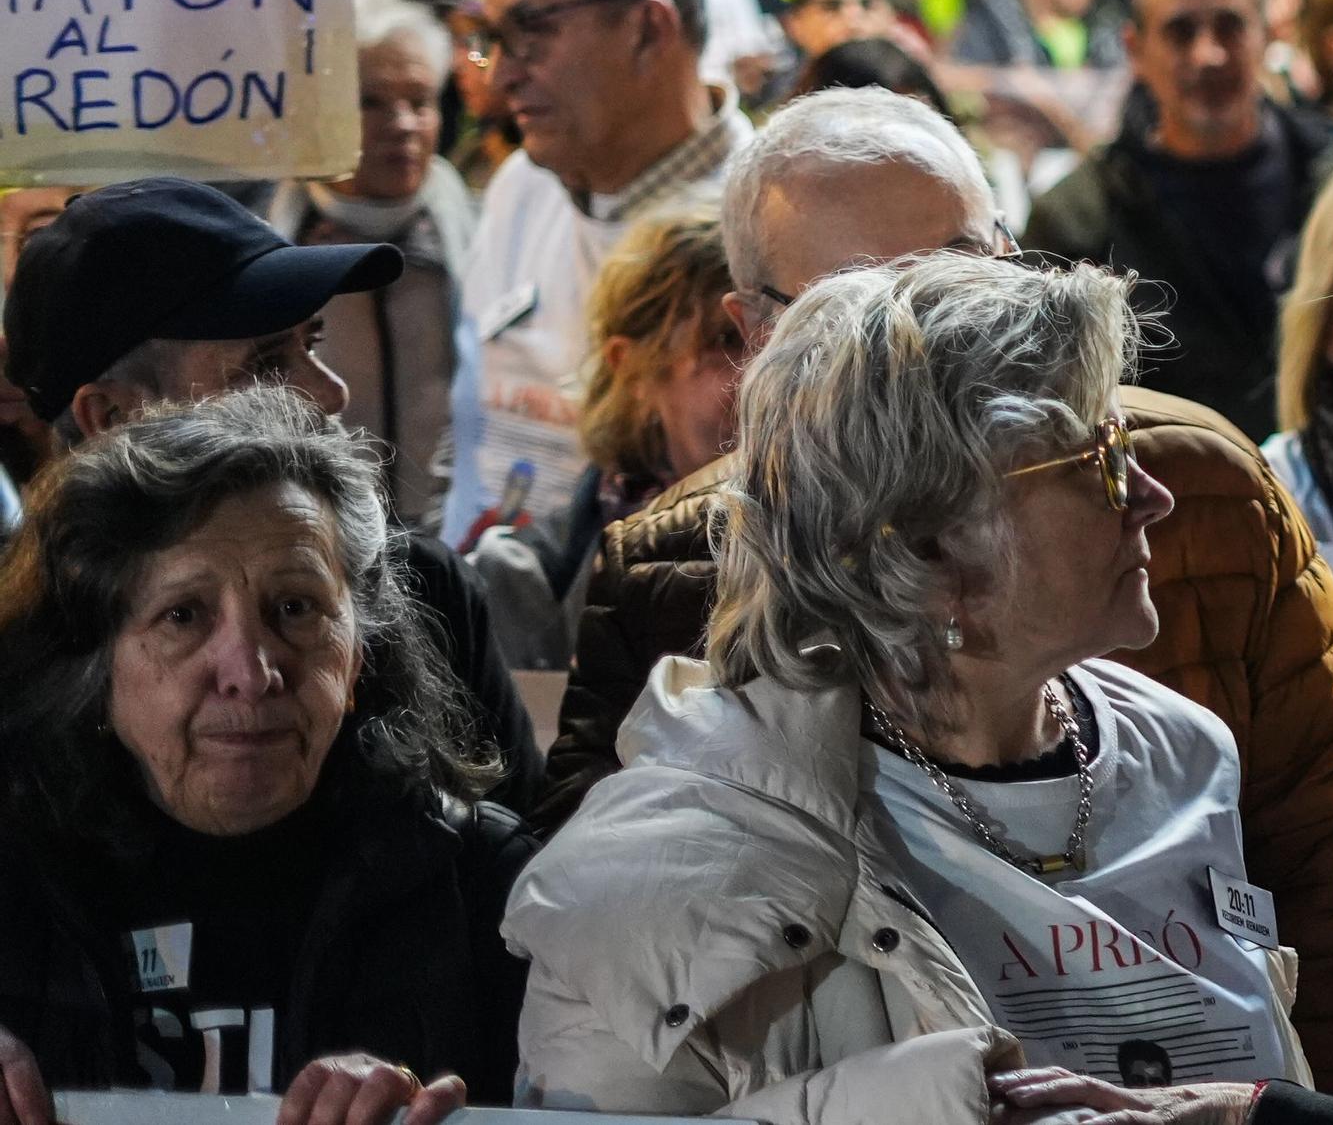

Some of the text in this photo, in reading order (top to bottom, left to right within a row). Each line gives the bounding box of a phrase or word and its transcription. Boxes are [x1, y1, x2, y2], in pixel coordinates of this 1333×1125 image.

[46, 16, 138, 59] AL
[0, 49, 285, 137] REDÓN
[1227, 886, 1256, 917] 20:11
[999, 932, 1039, 980] A
